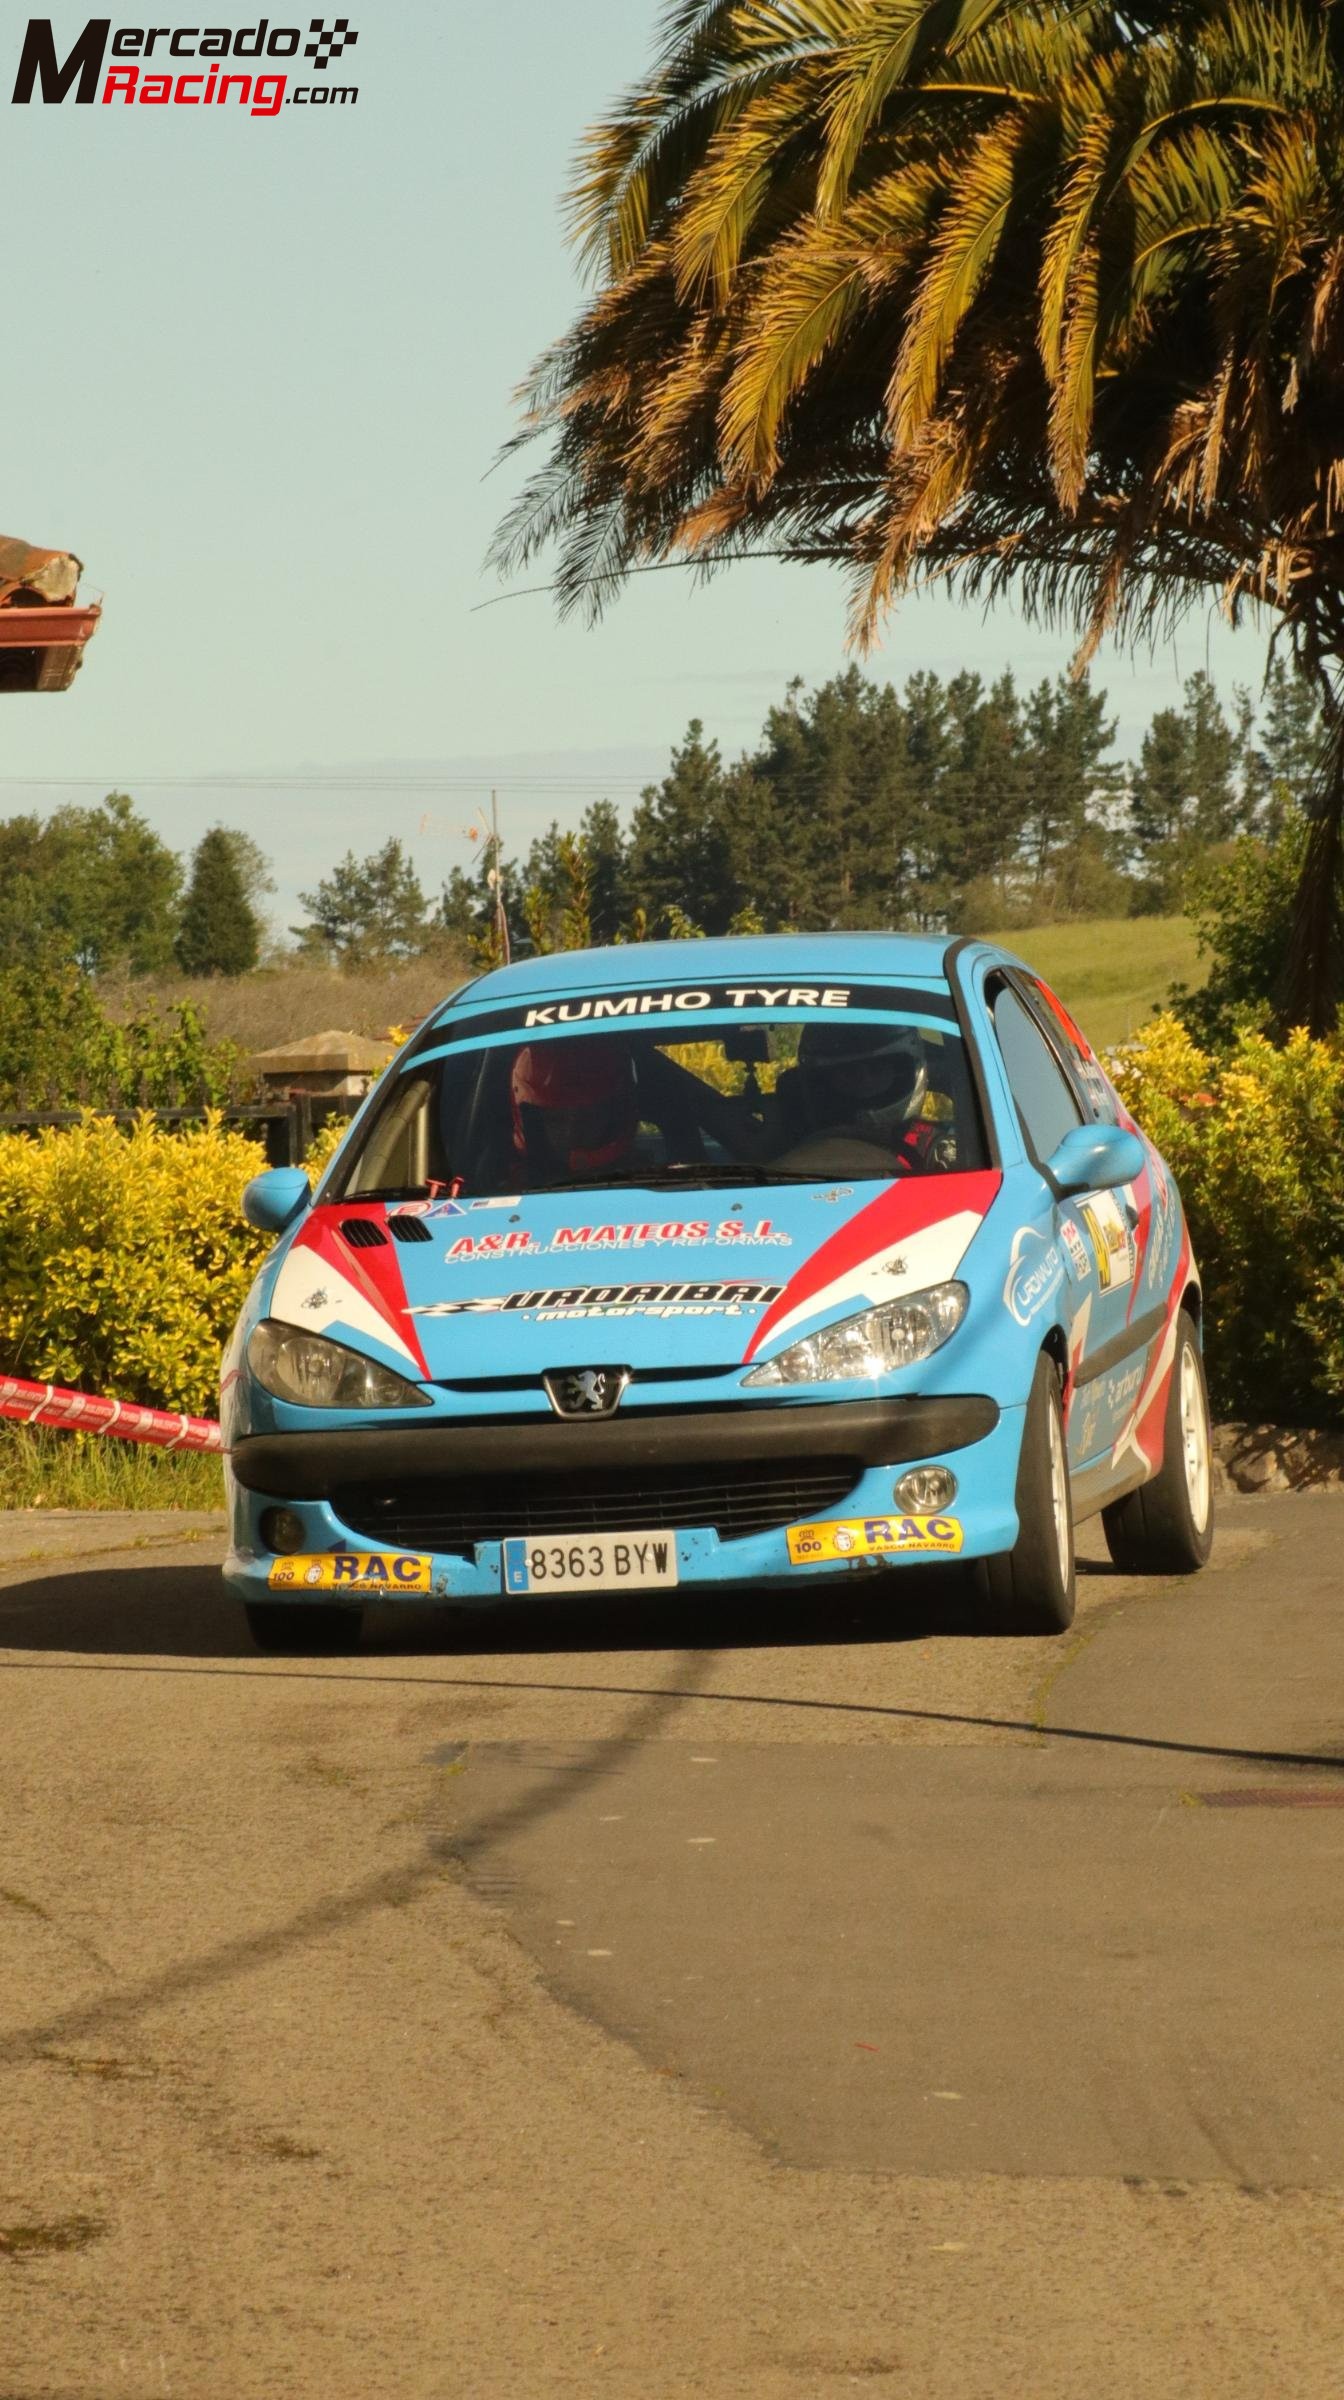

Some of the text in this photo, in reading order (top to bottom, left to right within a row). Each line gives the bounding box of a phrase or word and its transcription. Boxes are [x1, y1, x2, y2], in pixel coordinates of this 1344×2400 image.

[525, 988, 850, 1027] KUMHO TYRE
[552, 1220, 710, 1247] MATEOS
[671, 1236, 793, 1248] REFORMAS
[501, 1283, 788, 1313] URDAIBAI
[864, 1518, 956, 1544] RAC
[794, 1541, 822, 1554] 100
[907, 1542, 956, 1550] NAVARRO
[333, 1555, 421, 1582] RAC
[530, 1542, 668, 1580] 8363 BYW
[273, 1571, 295, 1582] 100
[513, 1571, 523, 1583] E
